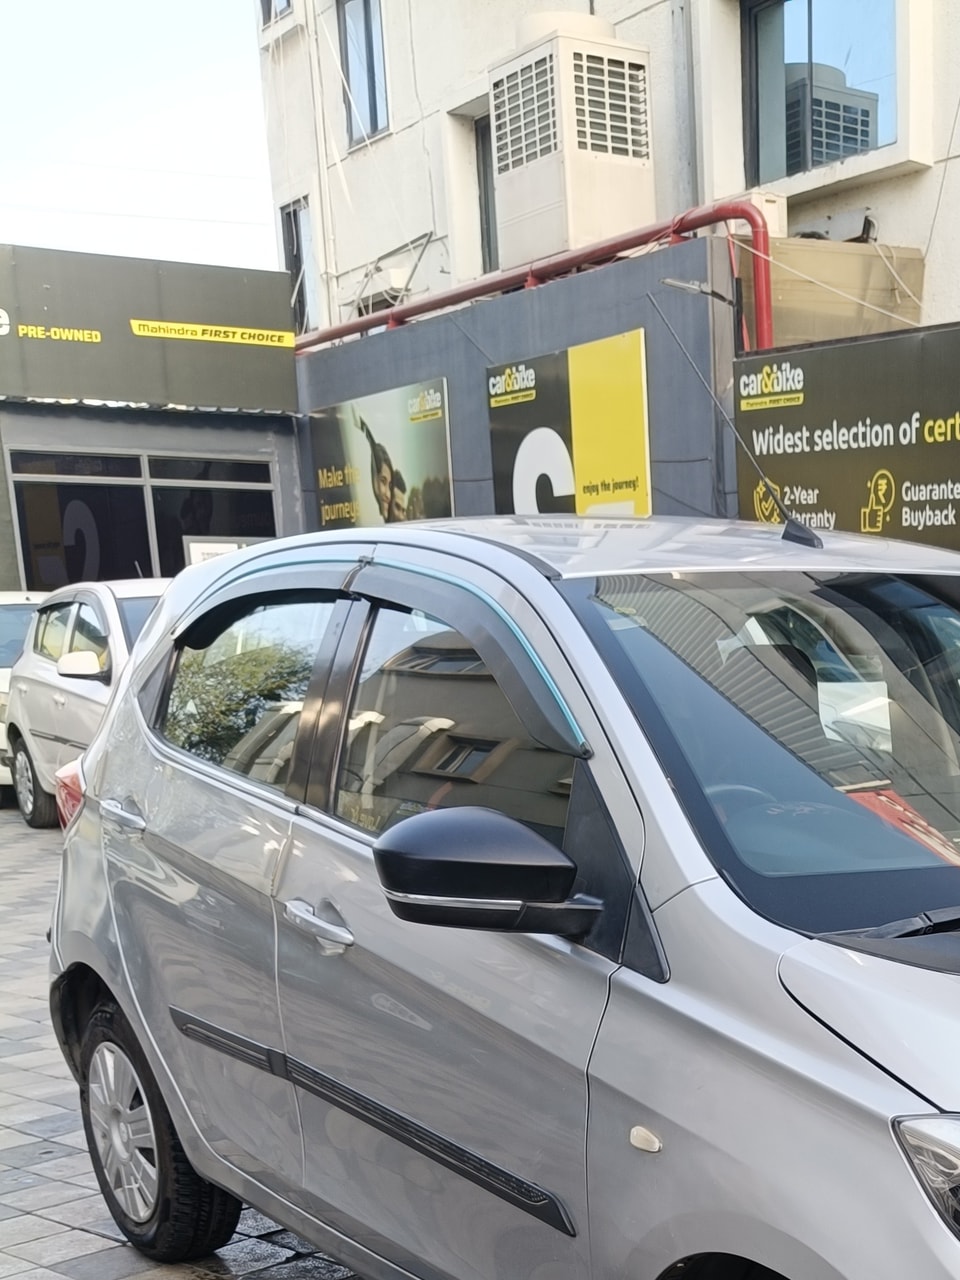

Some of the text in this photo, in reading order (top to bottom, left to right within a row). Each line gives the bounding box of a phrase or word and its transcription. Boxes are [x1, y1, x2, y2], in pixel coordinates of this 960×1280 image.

[18, 324, 101, 342] PRE-OWNED
[138, 323, 284, 343] Mahindra FIRST CHOICE
[489, 364, 536, 395] car&bike
[739, 361, 804, 397] car&bike
[752, 424, 811, 456] Widest
[814, 417, 894, 452] selection
[899, 412, 920, 446] of
[318, 464, 360, 489] Make the
[582, 476, 639, 496] enjoy the journey!
[783, 486, 820, 505] 2-Year
[901, 504, 957, 528] Buyback
